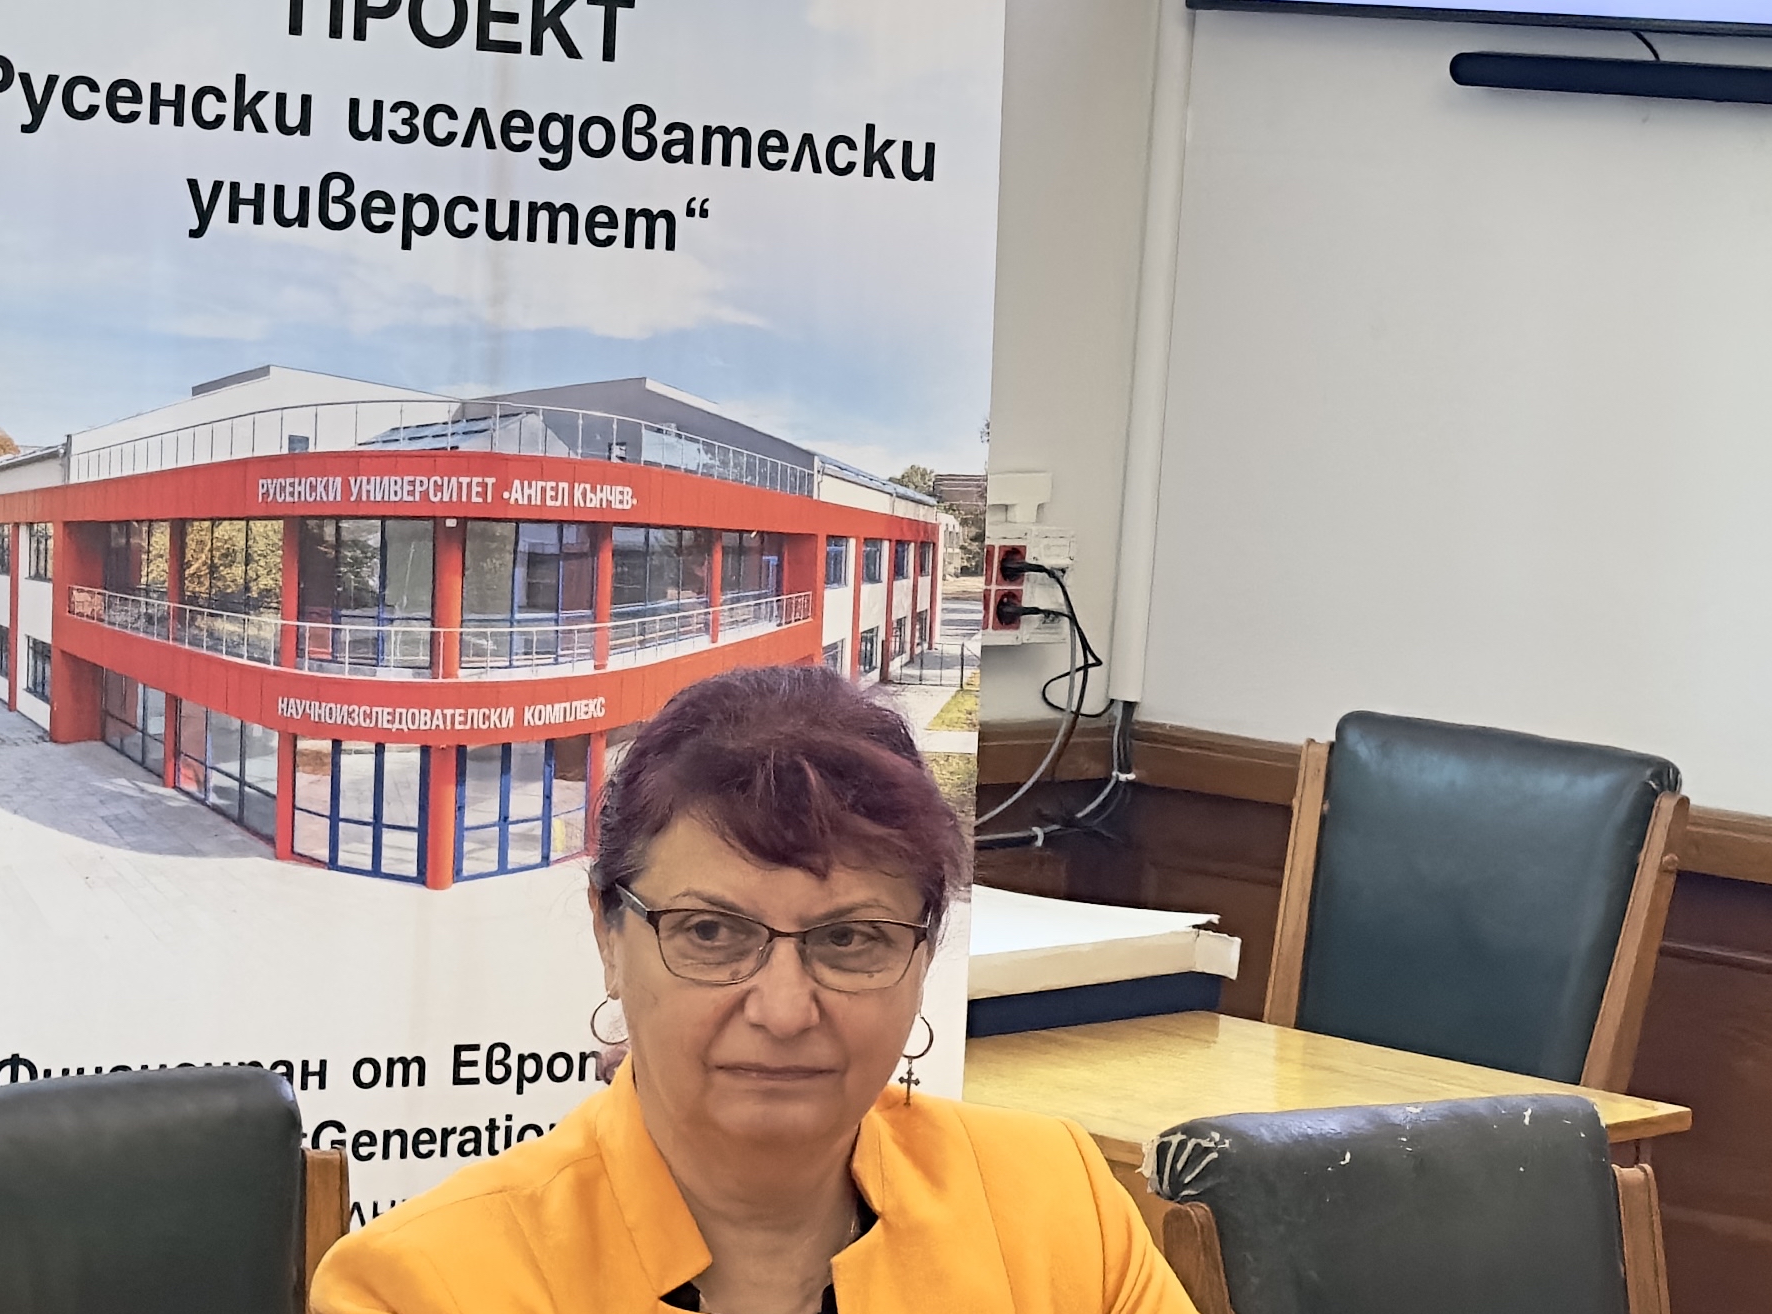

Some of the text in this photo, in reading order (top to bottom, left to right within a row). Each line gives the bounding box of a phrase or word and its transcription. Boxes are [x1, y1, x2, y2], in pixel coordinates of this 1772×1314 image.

[346, 90, 936, 183] изследователски
[187, 173, 710, 253] университет“
[257, 476, 342, 503] РУСЕНСКИ
[348, 476, 495, 503] УНИВЕРСИТЕТ
[278, 696, 605, 732] НАУЧНОИЗСЛЕДОВАТЕЛСКИ КОМПЛЕКС
[352, 1055, 426, 1089] от
[451, 1042, 605, 1095] Европ
[301, 1113, 557, 1162] Generatio
